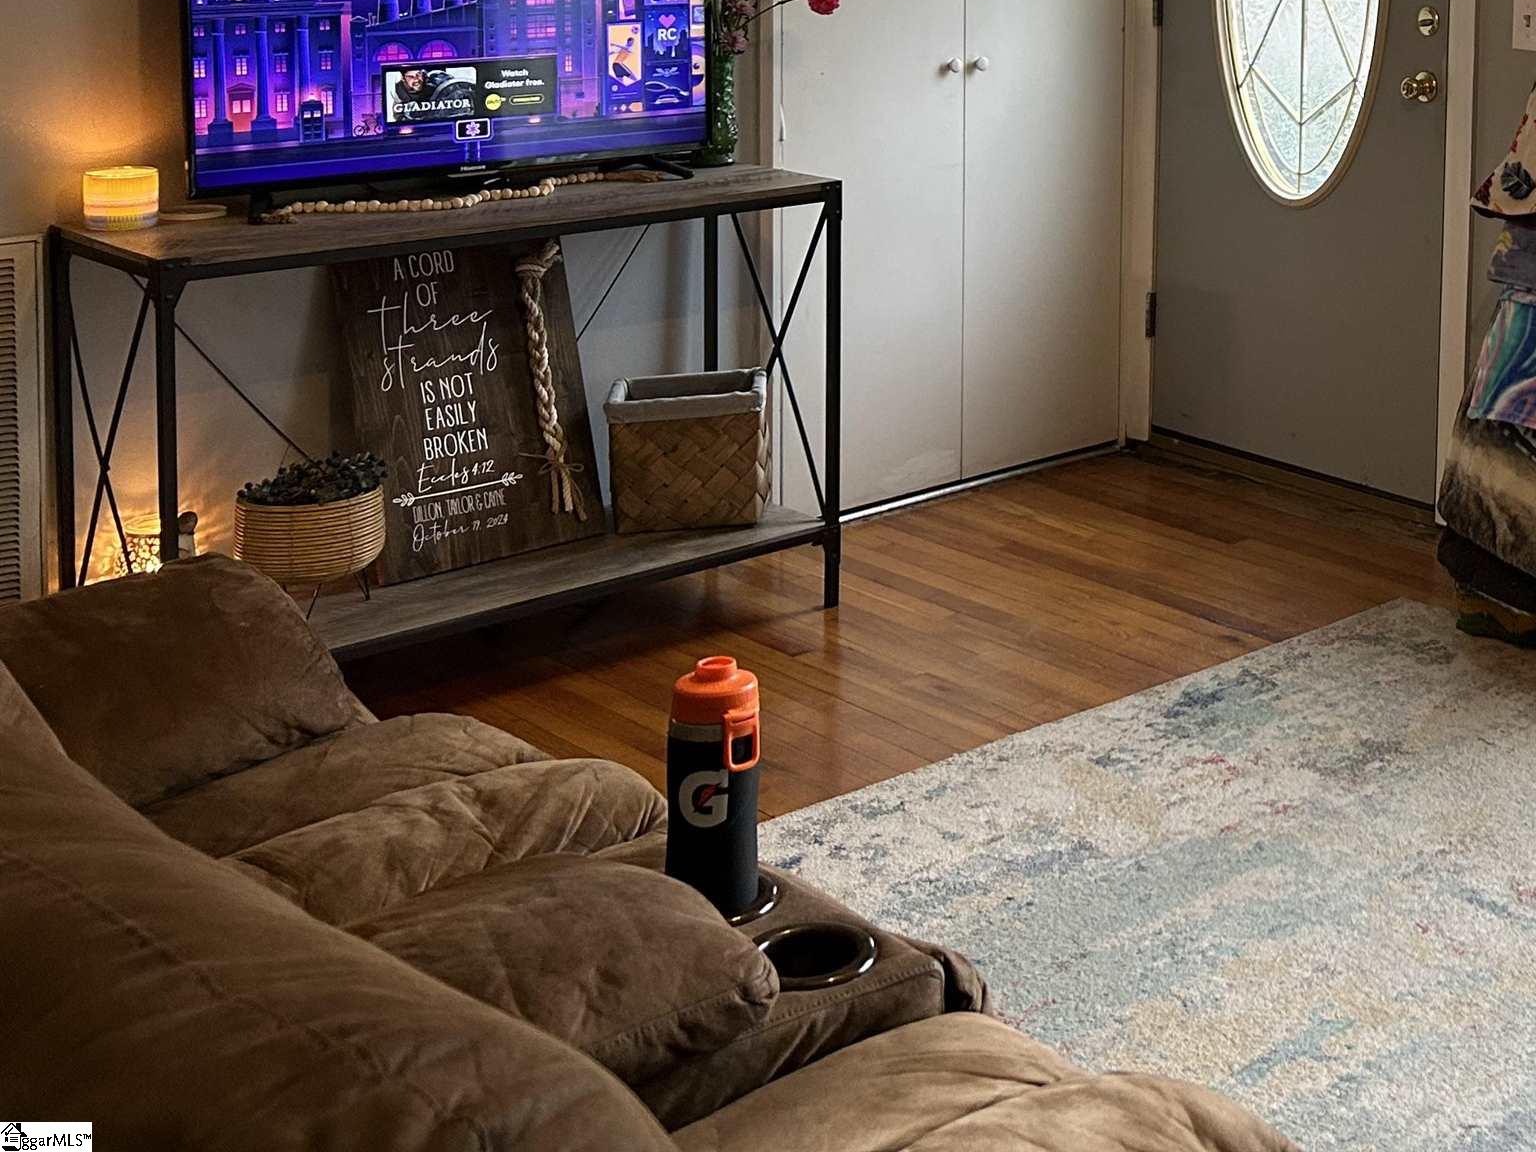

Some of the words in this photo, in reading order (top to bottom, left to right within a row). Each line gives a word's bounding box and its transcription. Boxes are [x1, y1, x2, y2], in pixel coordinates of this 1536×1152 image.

[657, 28, 677, 41] RC
[393, 98, 471, 113] GLADIATOR
[393, 258, 405, 281] A
[408, 250, 455, 279] CORD
[416, 281, 441, 308] OF
[367, 291, 493, 354] three
[380, 321, 499, 392] strands
[420, 381, 436, 404] IS
[439, 372, 474, 401] NOT
[425, 400, 477, 431] EASILY
[423, 427, 489, 461] BROKEN
[475, 493, 483, 511] &
[412, 519, 471, 552] October
[678, 769, 729, 828] G
